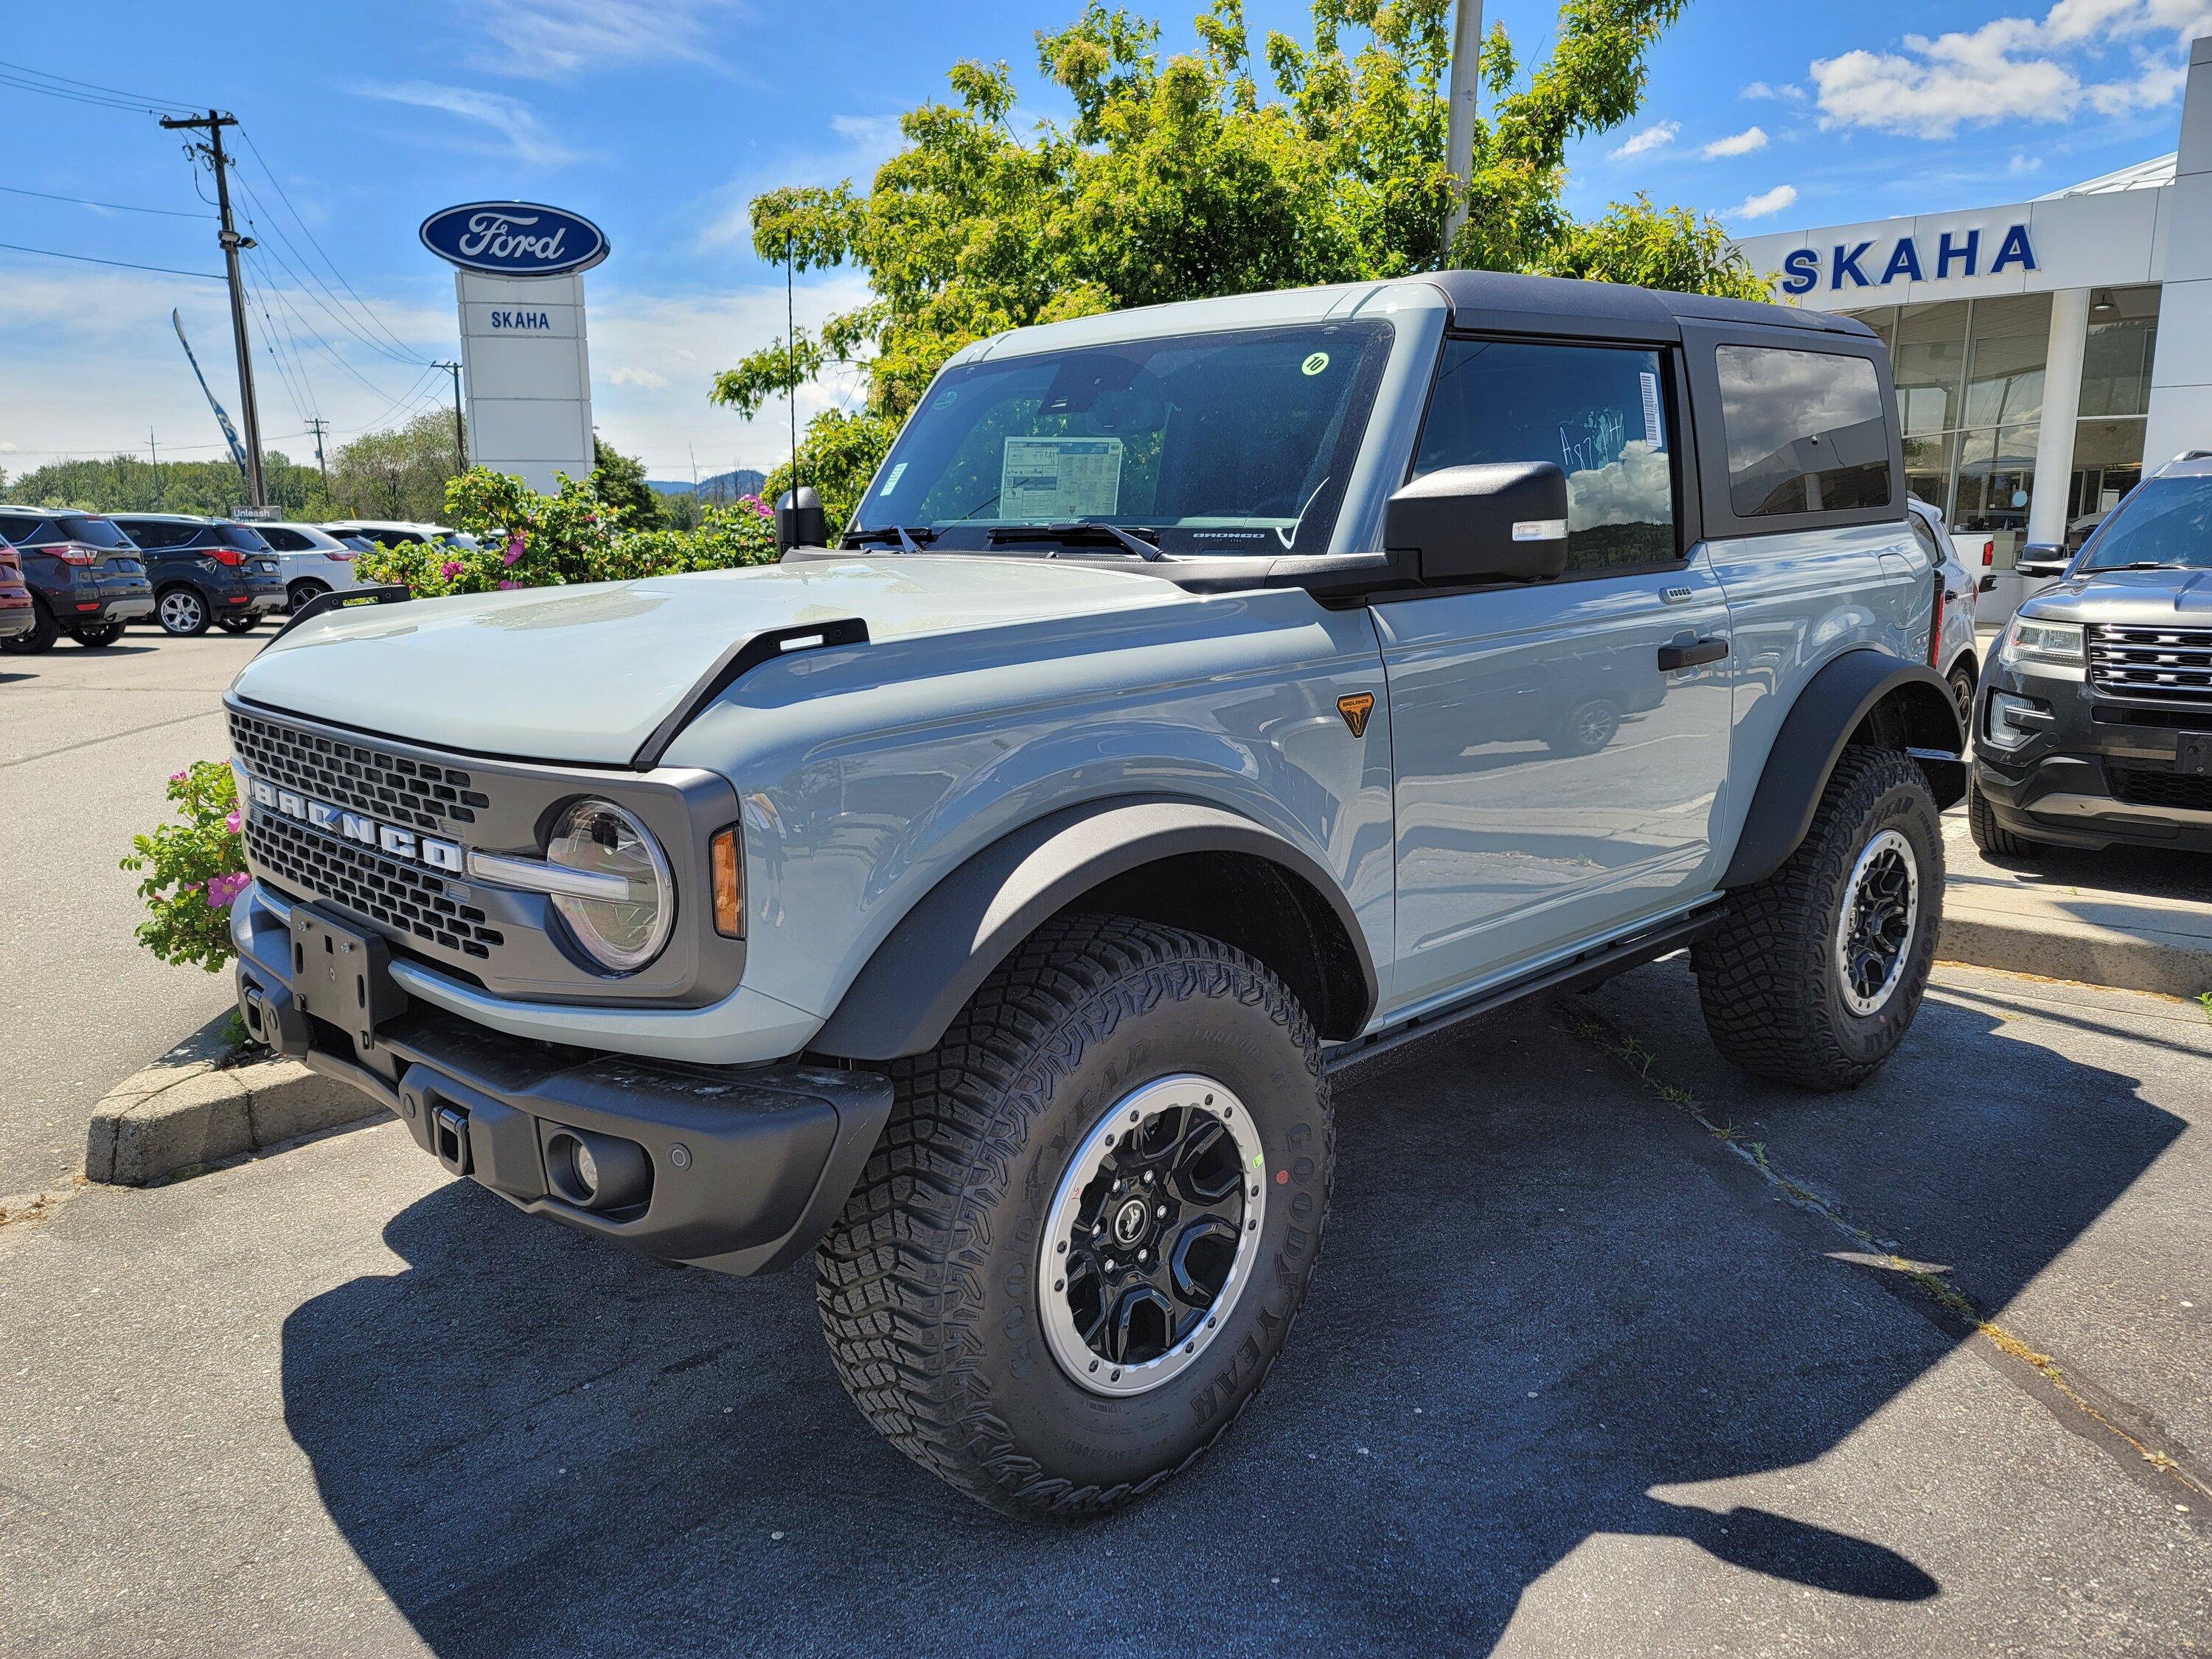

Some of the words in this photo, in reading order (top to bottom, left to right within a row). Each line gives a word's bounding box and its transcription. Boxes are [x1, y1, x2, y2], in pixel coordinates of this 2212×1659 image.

[459, 212, 566, 260] Ford
[1781, 223, 2041, 295] SKAHA
[492, 311, 551, 330] SKAHA
[1306, 356, 1325, 372] 10
[233, 509, 270, 518] Unleash
[1342, 698, 1369, 707] BADLANDS
[253, 777, 464, 873] BRONCO
